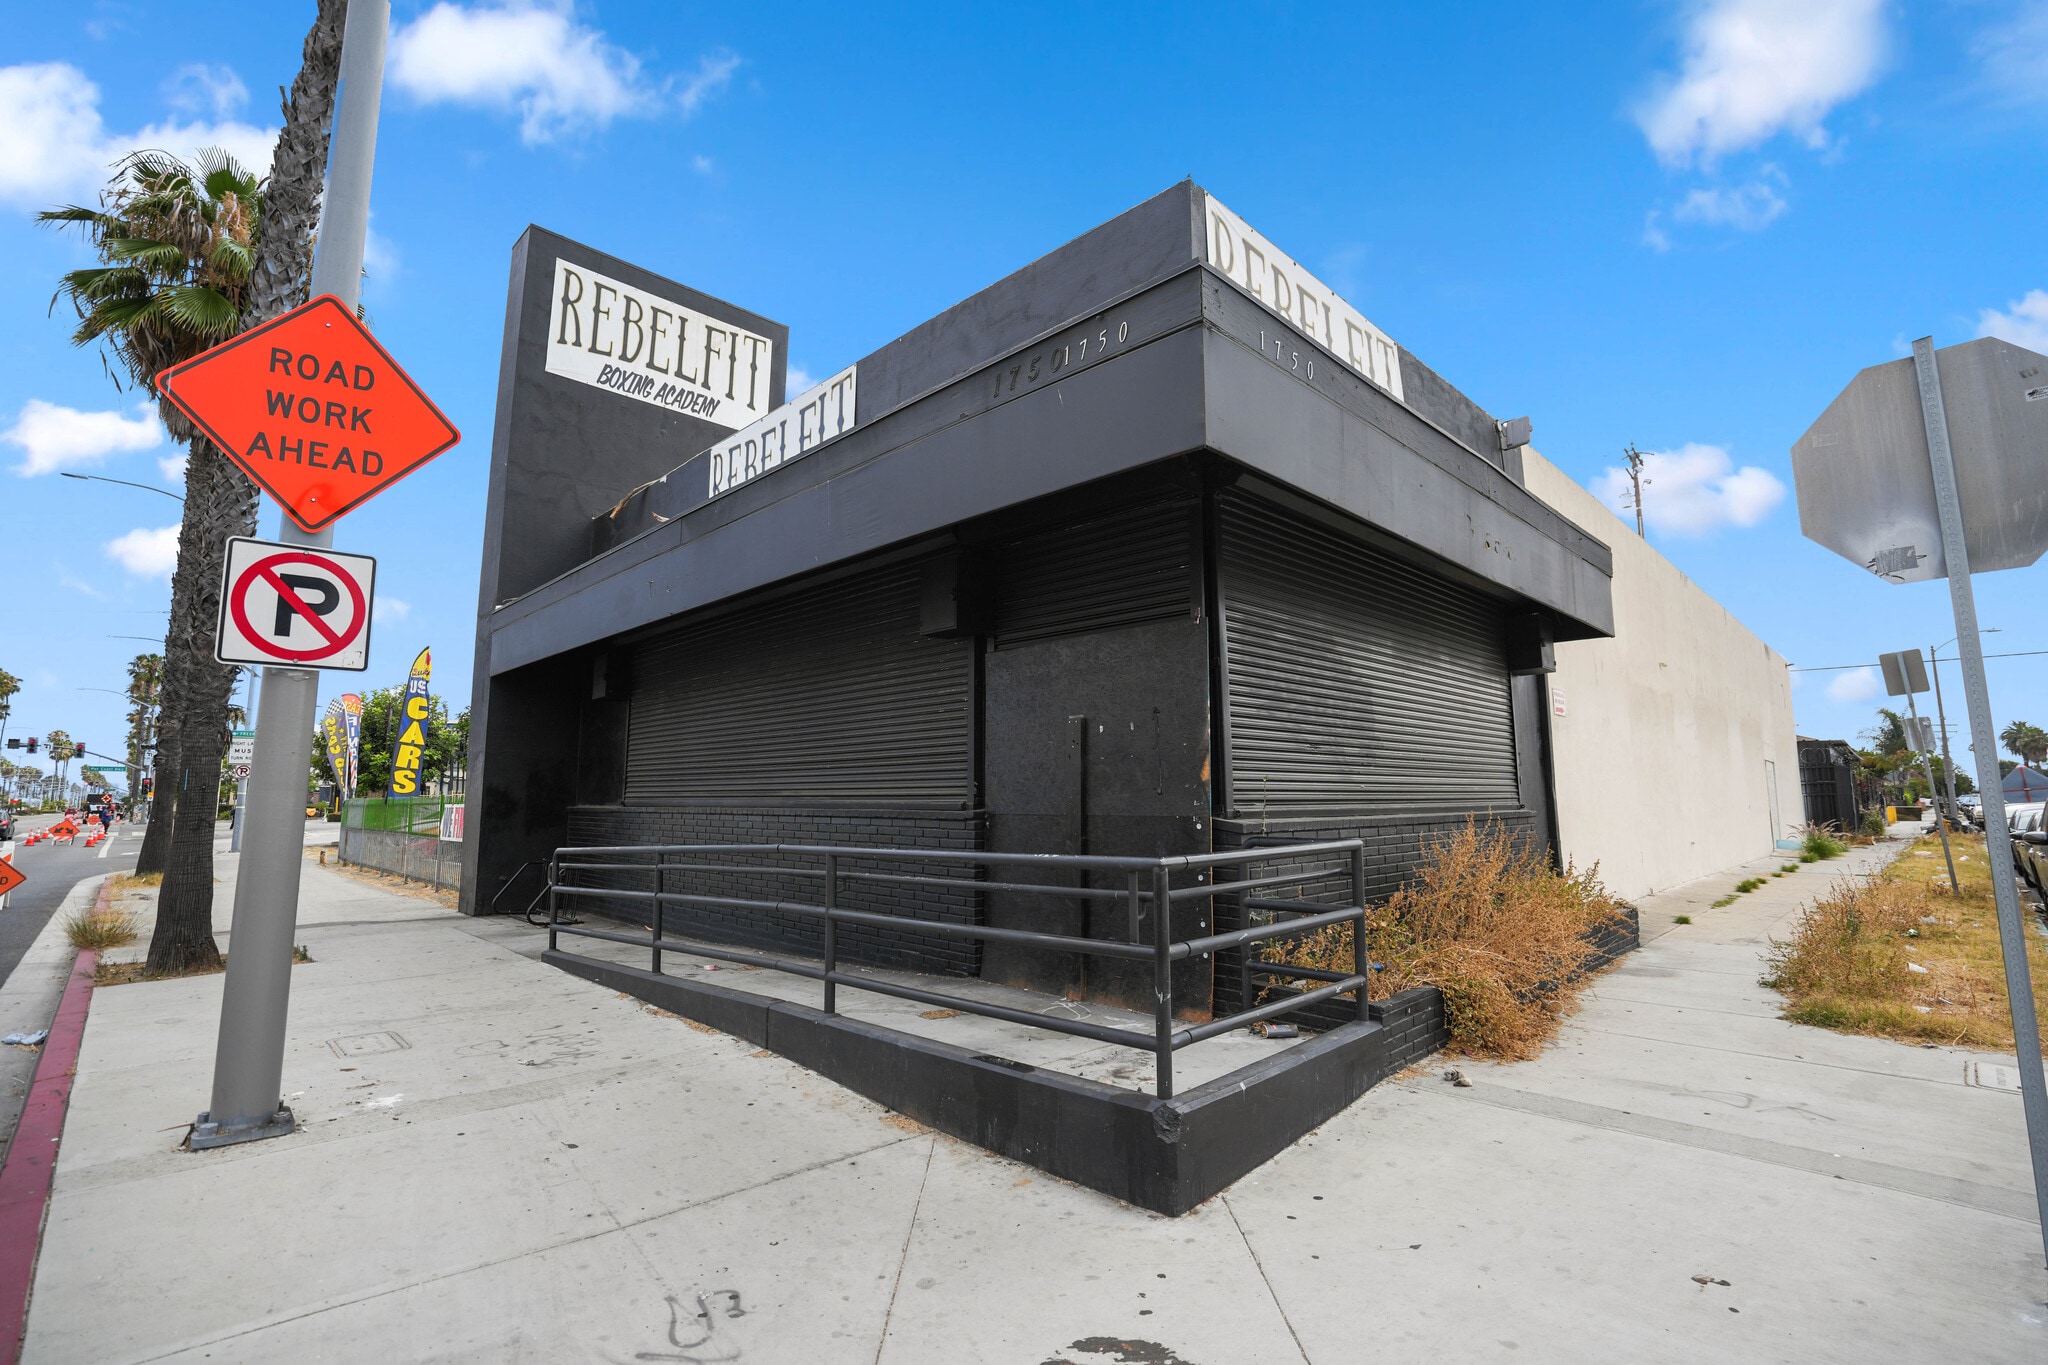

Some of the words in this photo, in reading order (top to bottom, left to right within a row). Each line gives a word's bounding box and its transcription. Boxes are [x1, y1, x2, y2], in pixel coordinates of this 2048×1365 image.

[557, 267, 767, 411] REBELFIT
[1064, 321, 1128, 366] 1750
[1259, 330, 1314, 380] 1750
[269, 347, 375, 391] ROAD
[596, 363, 654, 398] BOXING
[653, 381, 721, 418] ACADEMY
[266, 389, 372, 434] WORK
[246, 432, 384, 477] AHEAD
[392, 696, 429, 794] CARS
